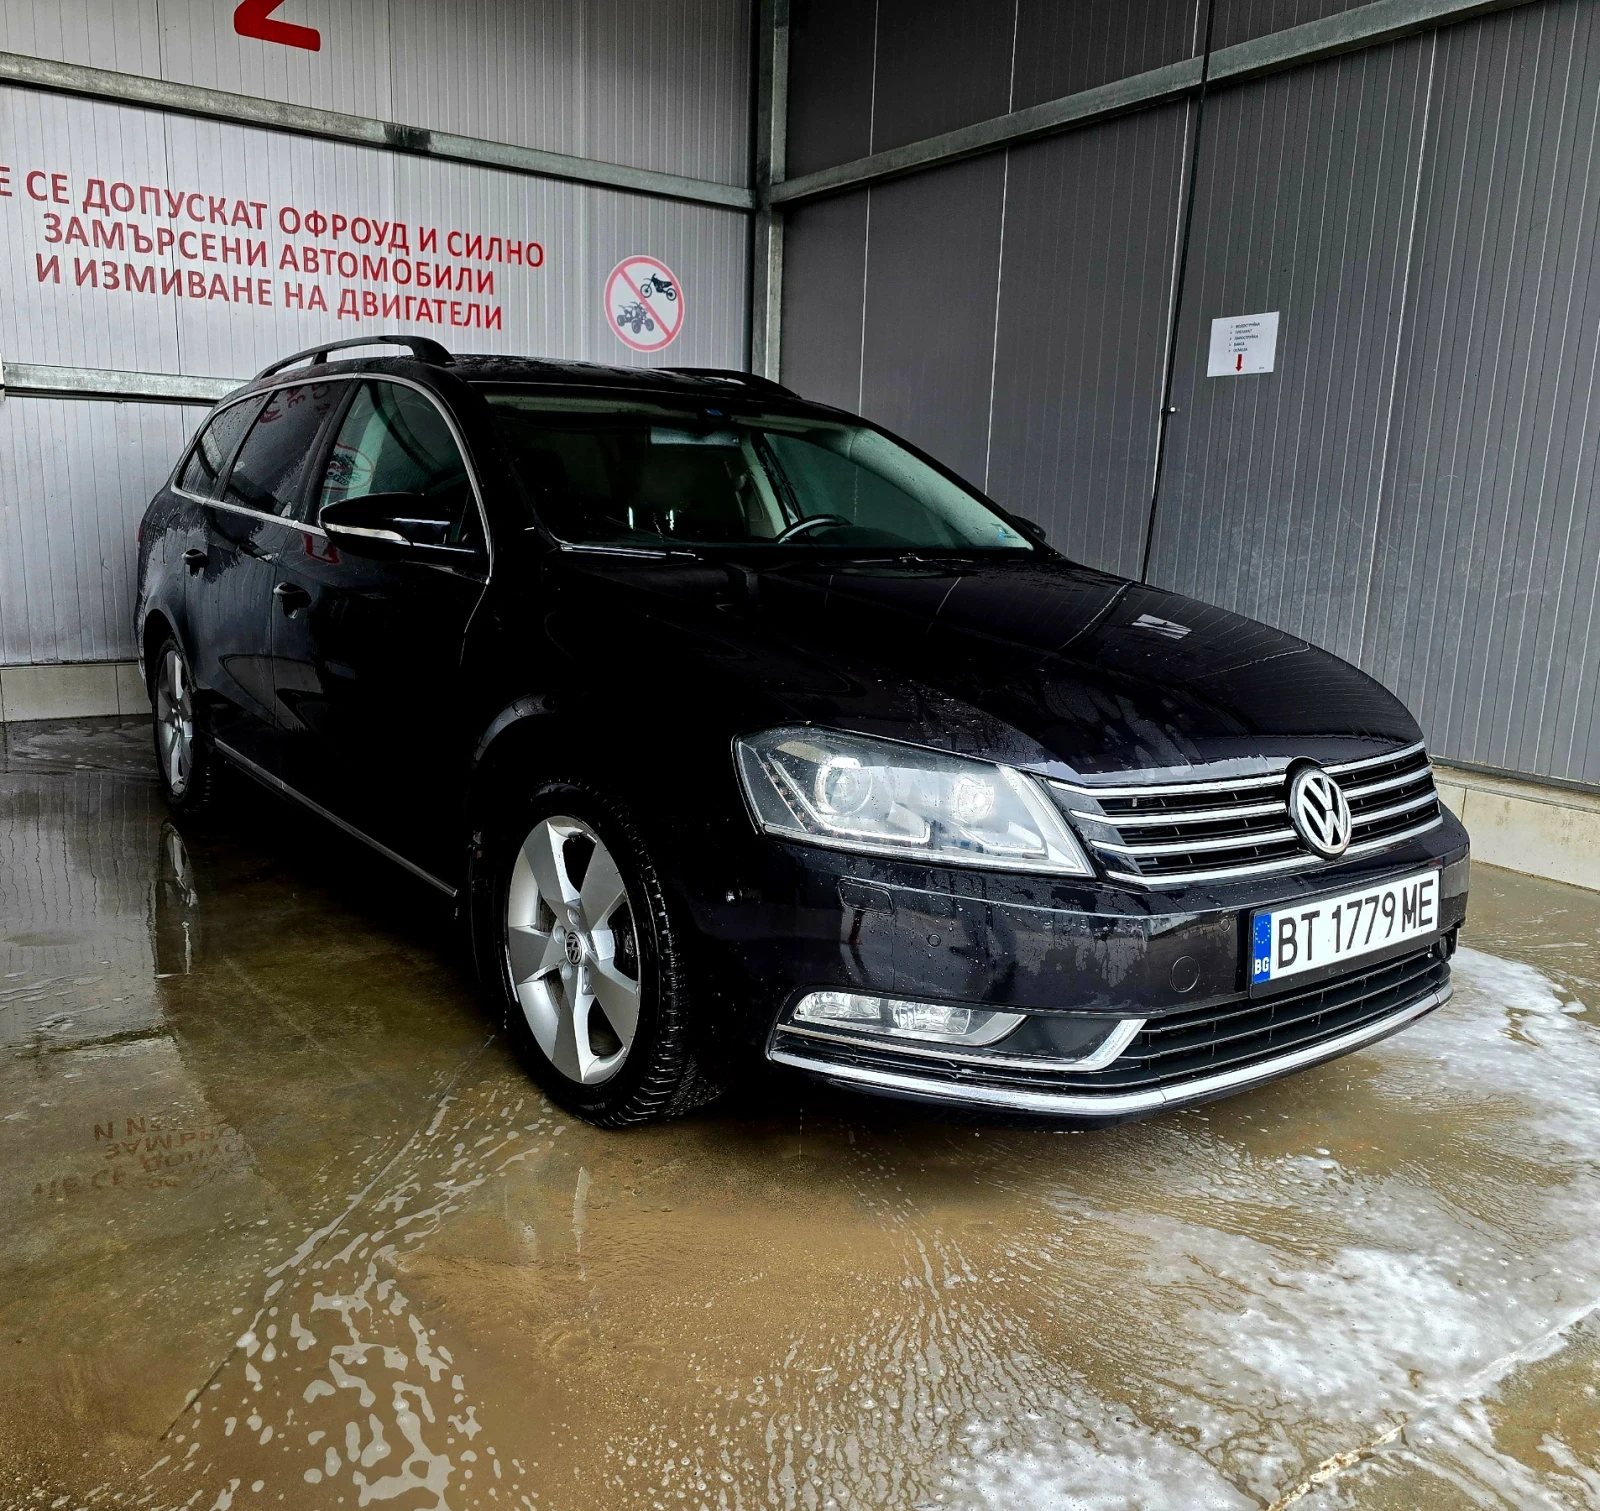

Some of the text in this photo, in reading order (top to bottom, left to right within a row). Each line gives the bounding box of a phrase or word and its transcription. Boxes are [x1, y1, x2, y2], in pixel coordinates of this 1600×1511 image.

[26, 170, 69, 204] СЕ
[82, 178, 268, 230] ДОПУСКАТ
[279, 206, 410, 256] ОФРОУД
[419, 226, 437, 254] И
[447, 231, 544, 268] СИЛНО
[43, 212, 494, 295] ЗАМЪРСЕНИ АВТОМОБИЛИ
[35, 253, 502, 330] И ИЗМИВАНЕ НА ДВИГАТЕЛИ
[1254, 957, 1270, 975] BG
[1277, 879, 1434, 970] BT 1779 ME
